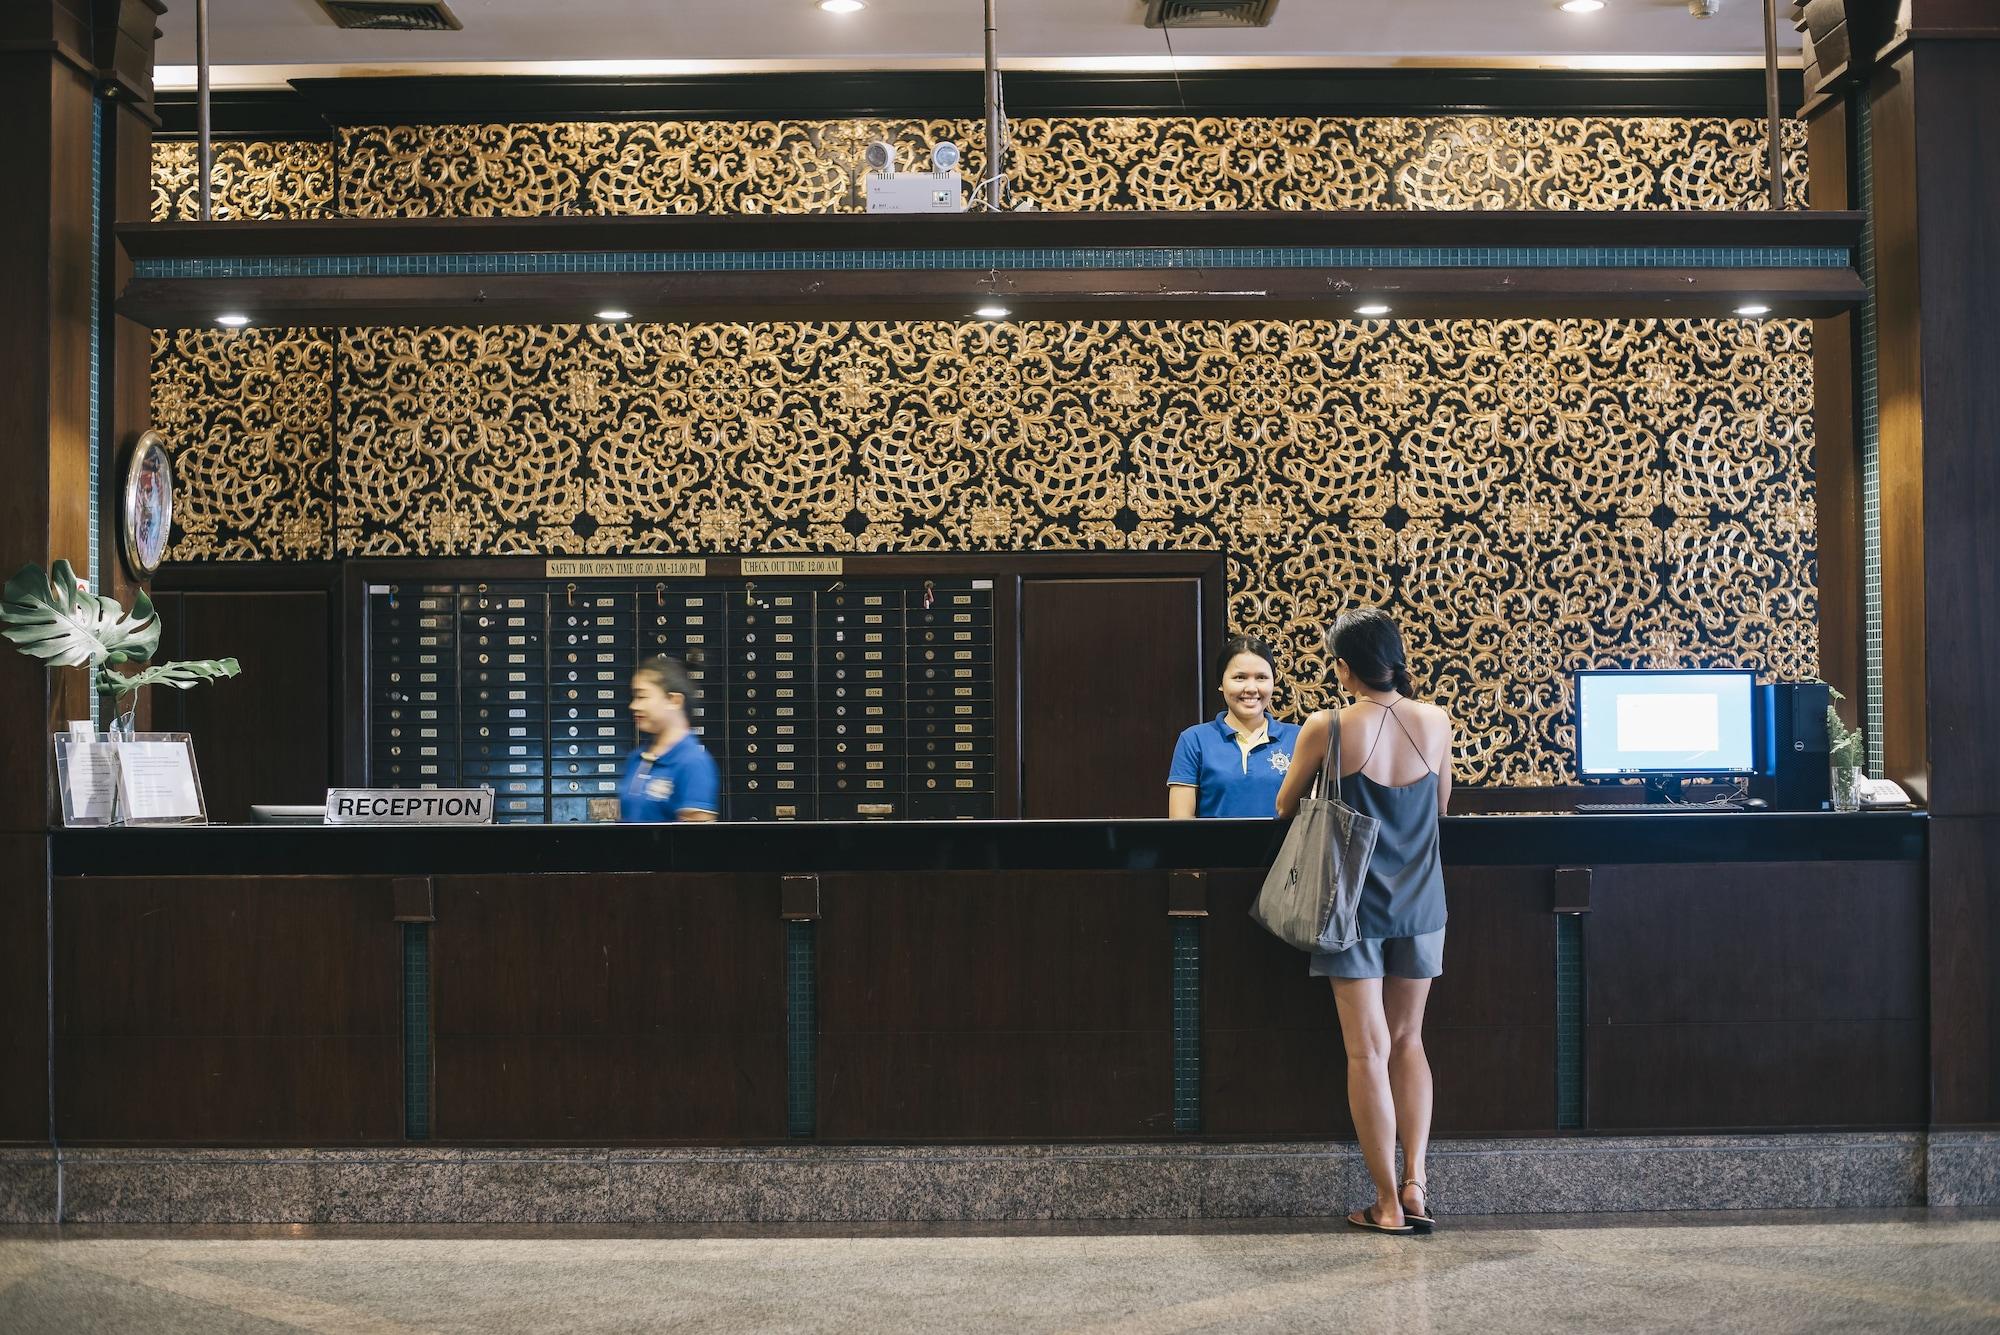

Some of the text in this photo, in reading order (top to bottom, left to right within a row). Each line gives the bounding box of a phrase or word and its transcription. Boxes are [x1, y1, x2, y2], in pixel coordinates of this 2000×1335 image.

[551, 563, 576, 574] SAFETY
[580, 563, 593, 574] BOX
[596, 563, 614, 574] OPEN
[616, 562, 634, 574] TIME
[744, 561, 769, 572] CHECK
[772, 561, 786, 572] OUT
[788, 561, 806, 572] TIME
[338, 798, 482, 816] RECEPTION
